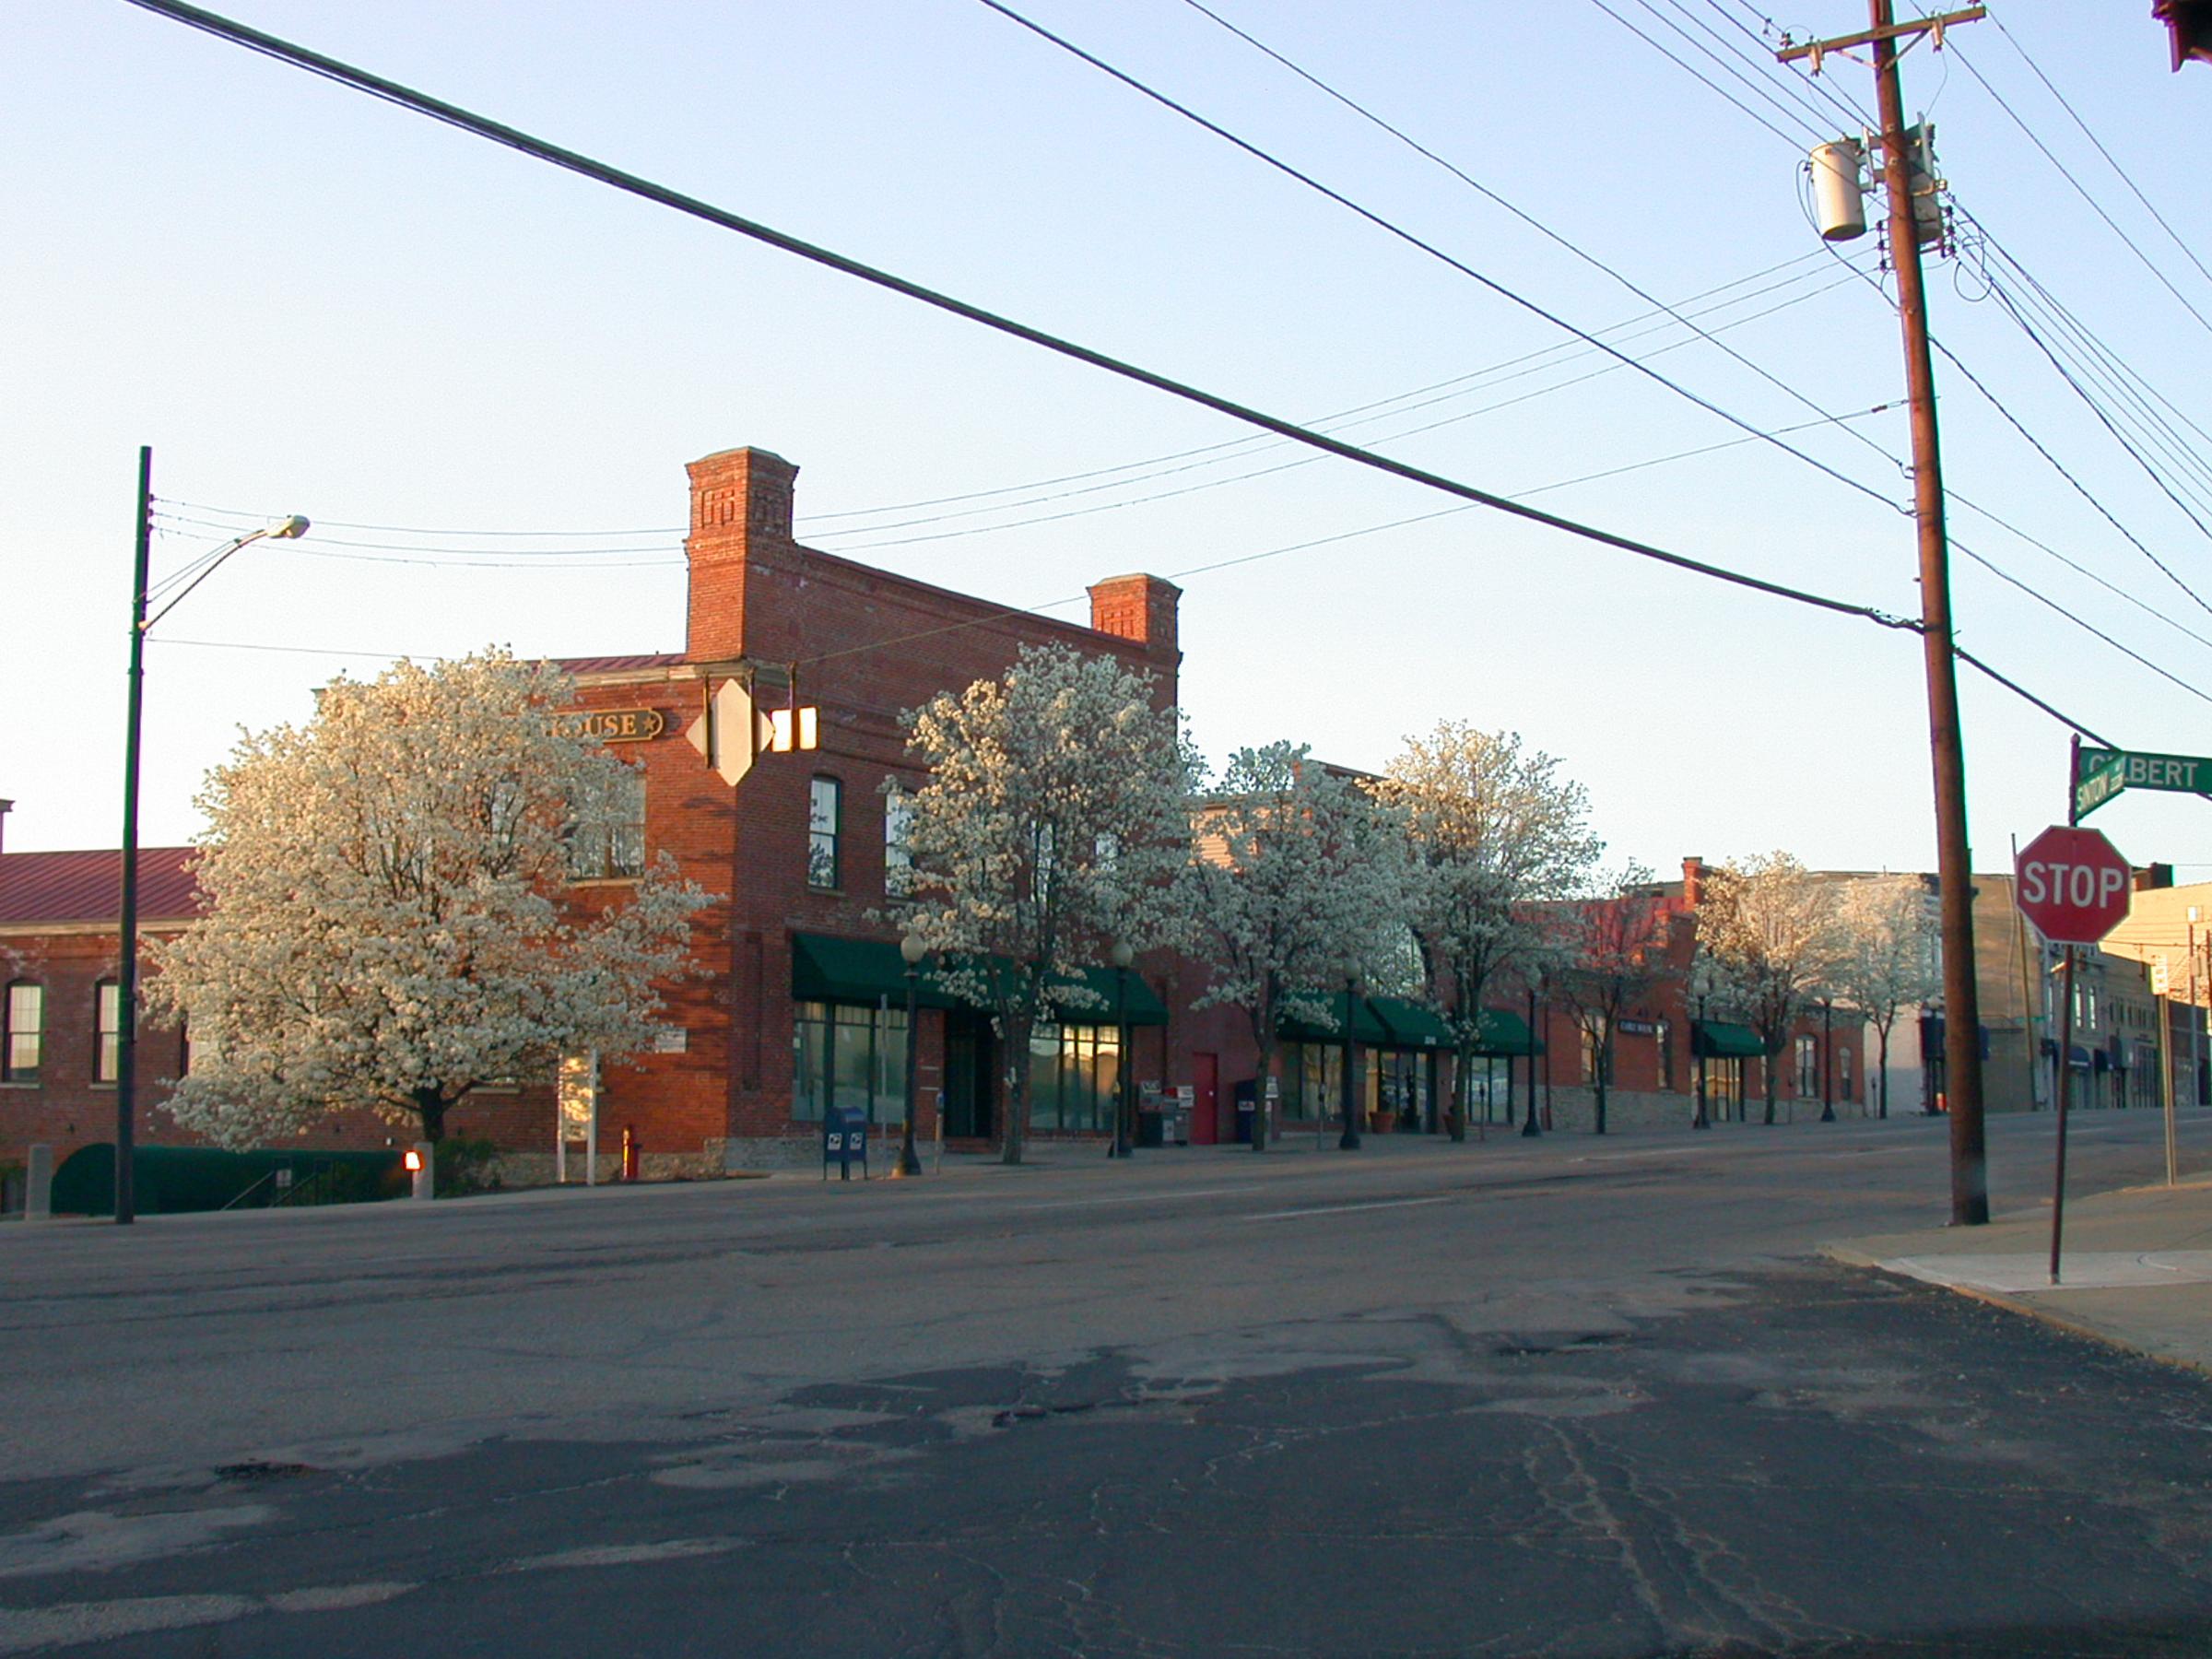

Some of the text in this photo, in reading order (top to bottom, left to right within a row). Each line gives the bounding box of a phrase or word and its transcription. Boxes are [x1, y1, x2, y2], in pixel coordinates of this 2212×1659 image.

[551, 714, 637, 736] USE
[2089, 754, 2198, 787] BERT
[2023, 861, 2123, 908] STOP
